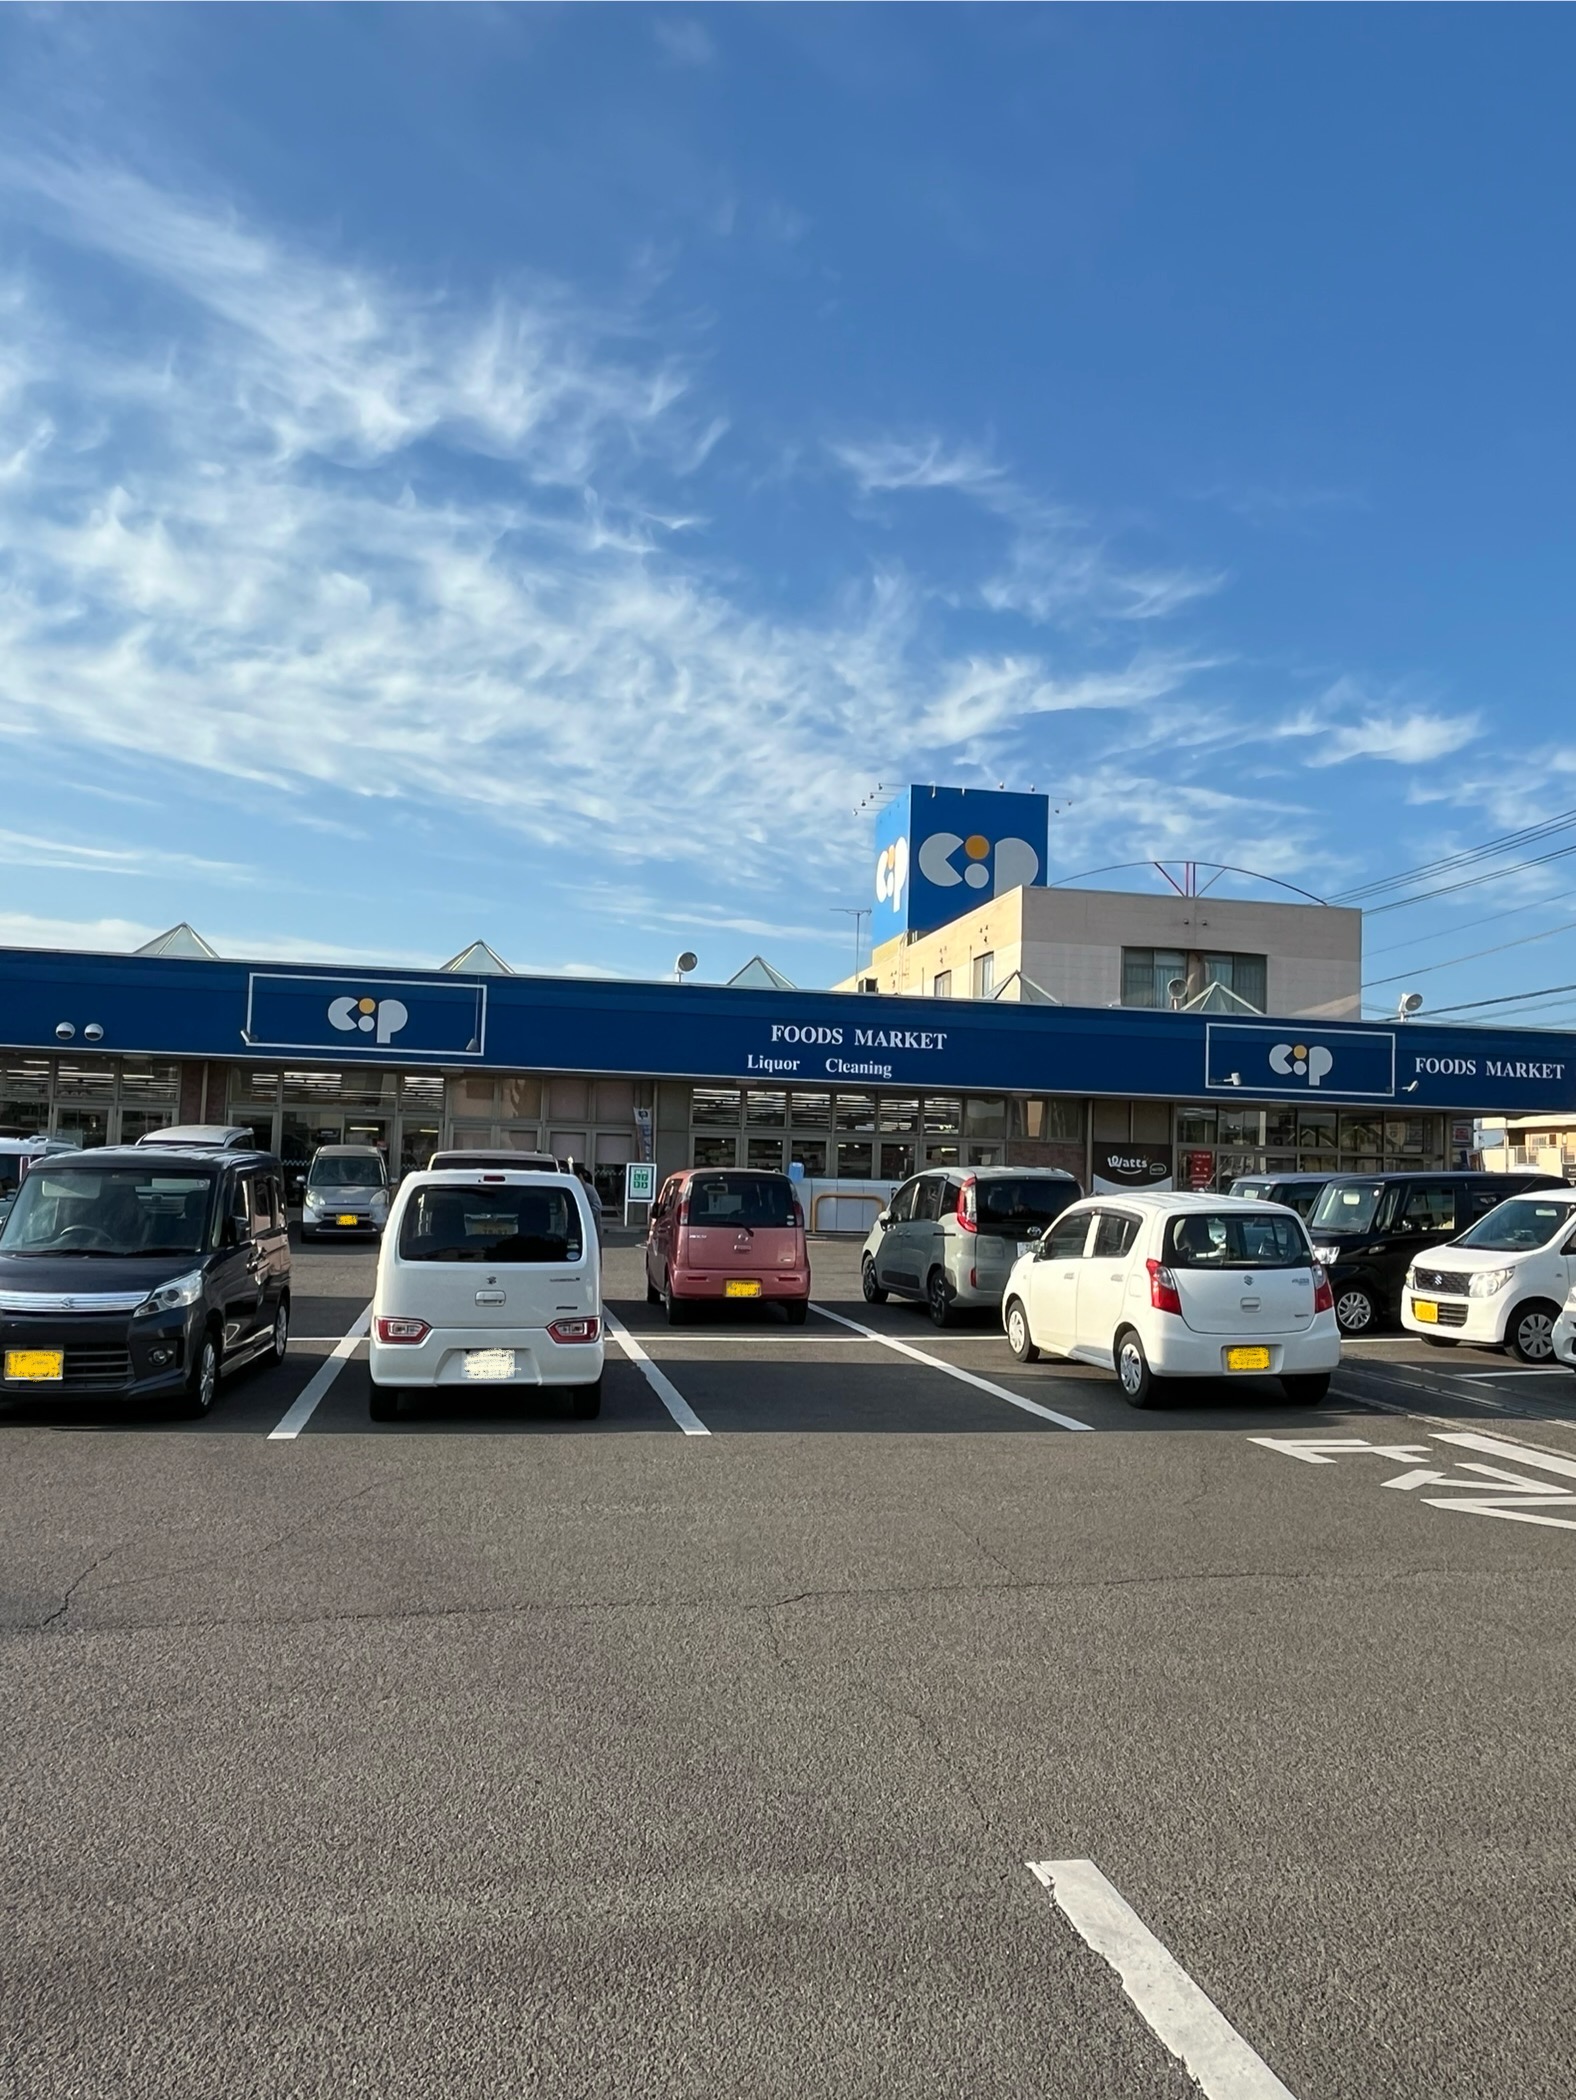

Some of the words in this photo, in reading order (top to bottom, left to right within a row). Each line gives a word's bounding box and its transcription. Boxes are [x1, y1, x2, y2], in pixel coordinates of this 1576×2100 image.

[771, 1025, 843, 1045] FOODS
[854, 1029, 947, 1050] MARKET
[747, 1054, 800, 1072] Liquor
[825, 1058, 892, 1078] Cleaning
[1415, 1057, 1476, 1075] FOODS
[1486, 1061, 1565, 1079] MARKET
[1107, 1155, 1147, 1168] Watts
